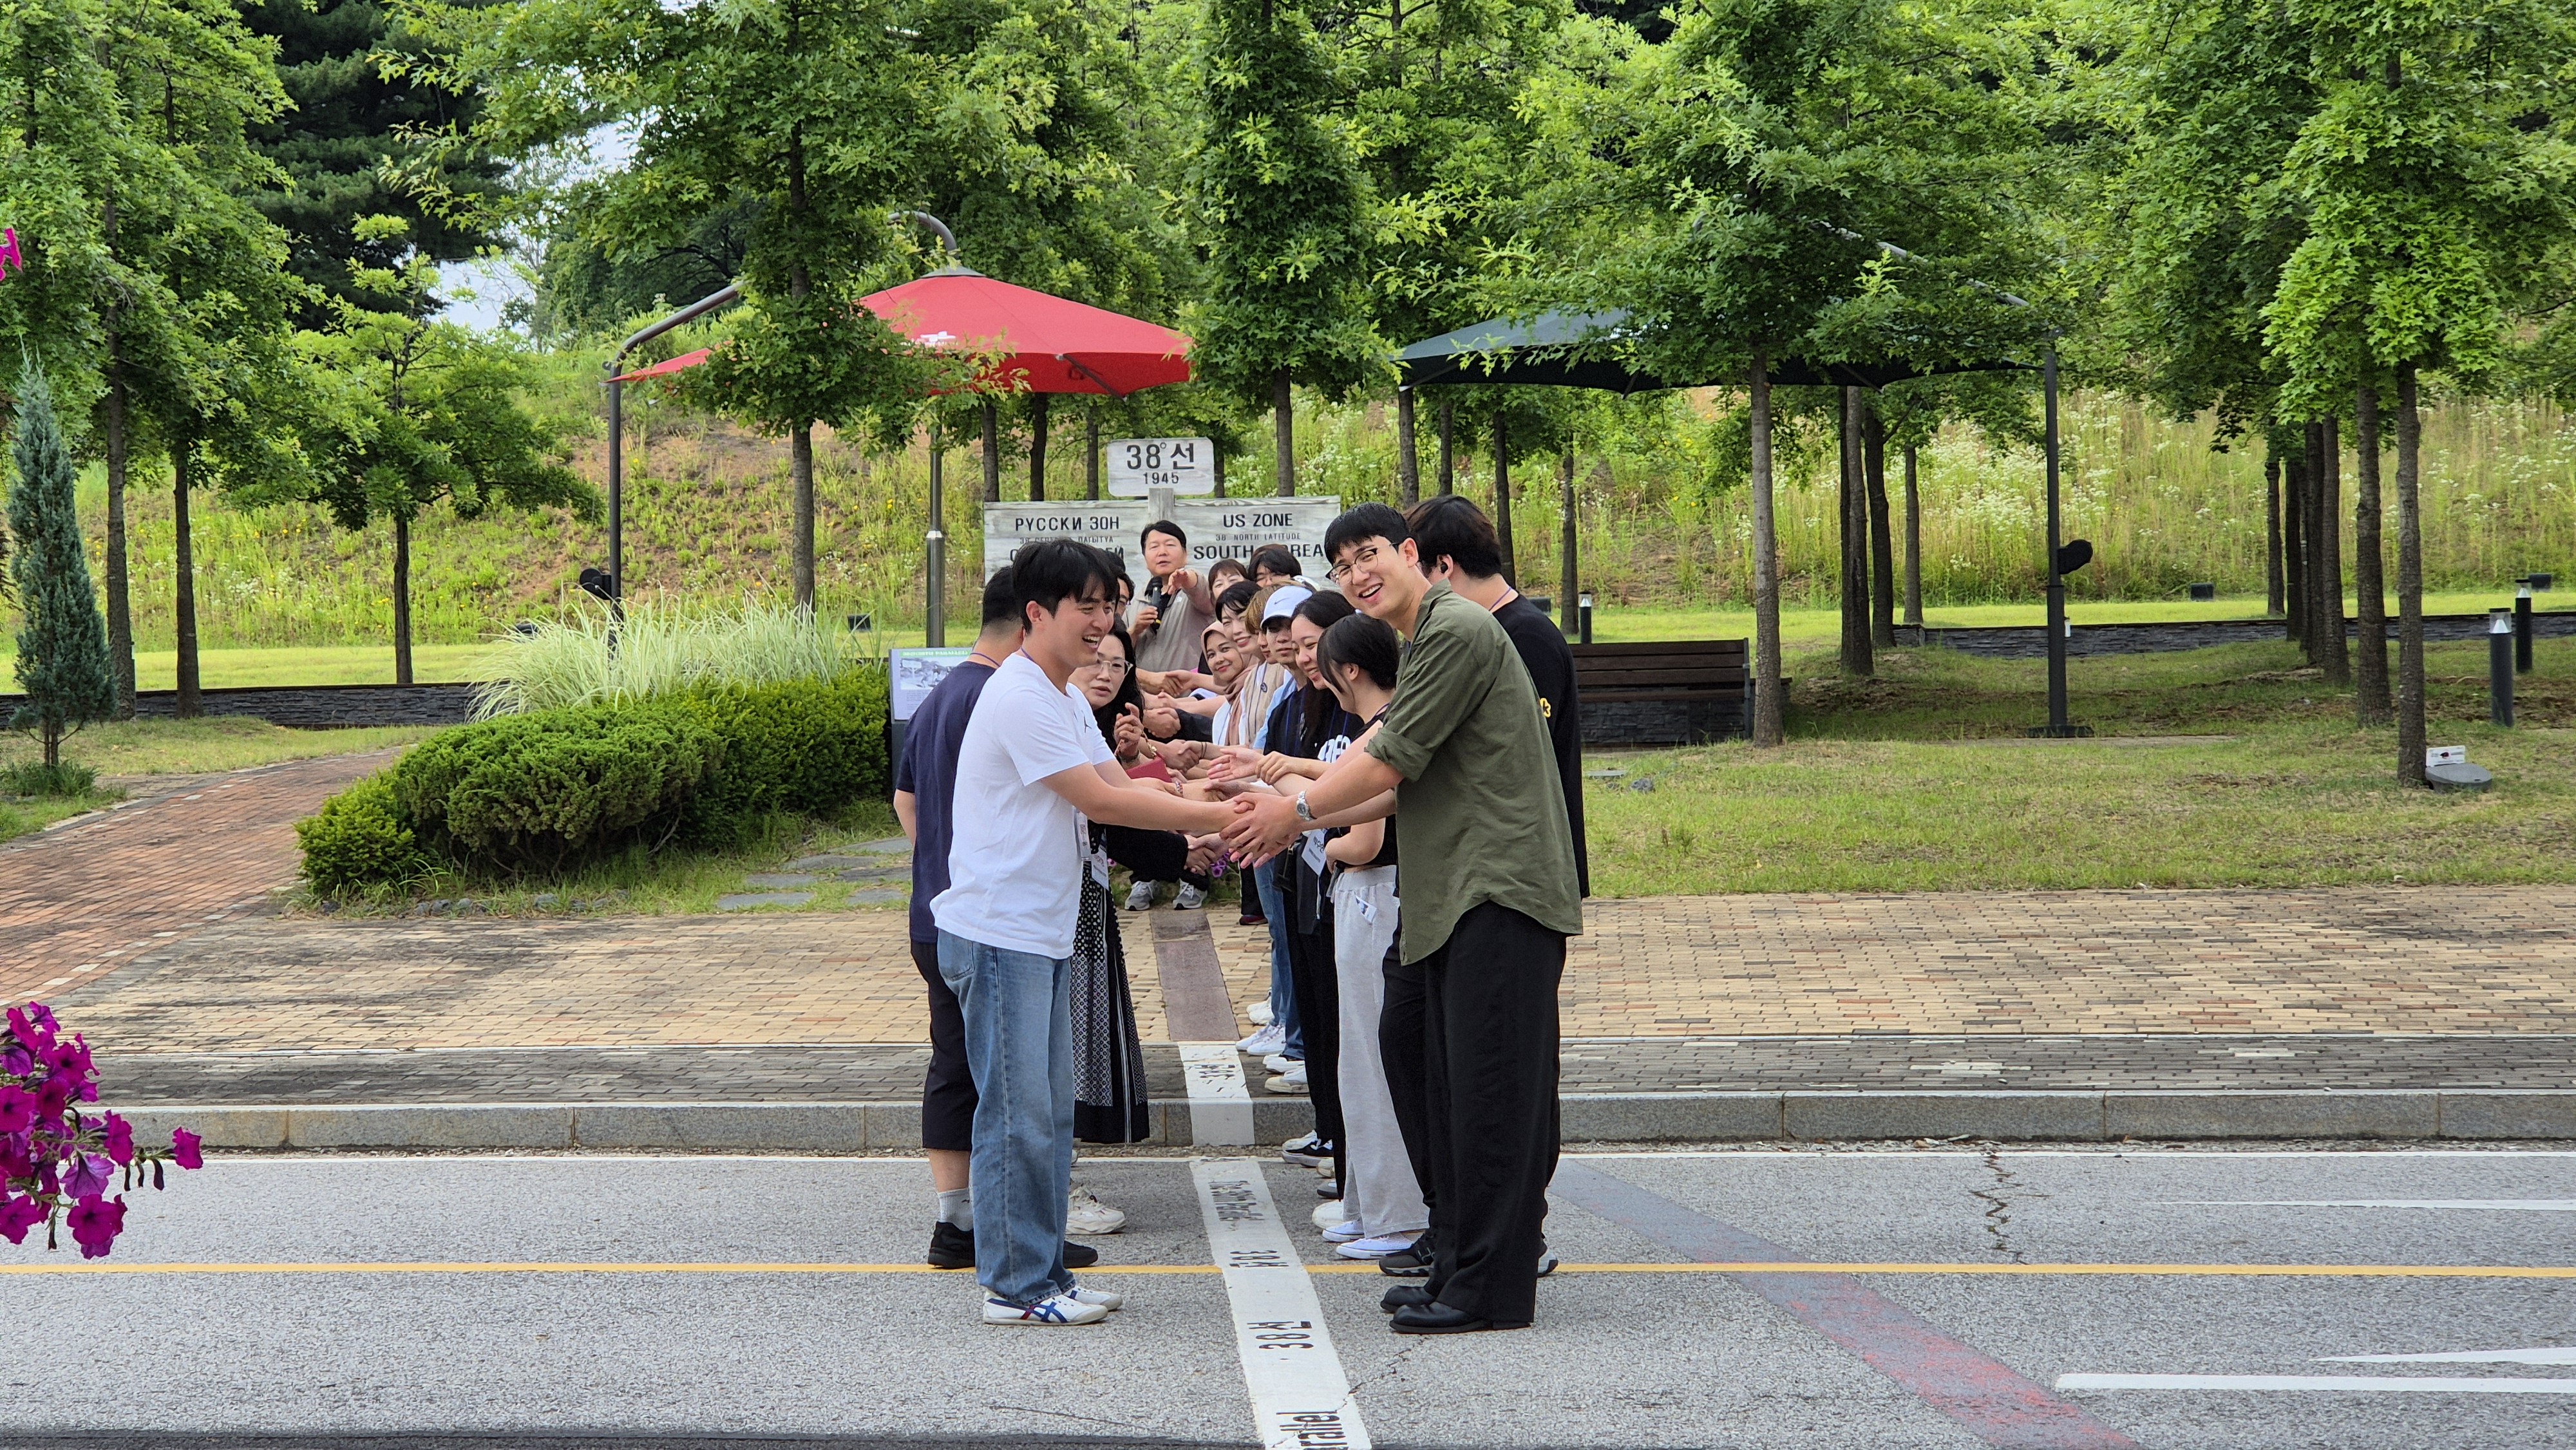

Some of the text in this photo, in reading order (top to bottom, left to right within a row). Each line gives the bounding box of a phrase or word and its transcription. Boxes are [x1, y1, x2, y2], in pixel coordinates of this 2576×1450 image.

[1126, 442, 1195, 470] 38°선
[1143, 472, 1179, 484] 1945
[1015, 516, 1119, 531] РУССКИ ЗОН
[1223, 513, 1293, 527] US ZONE
[1193, 544, 1324, 560] SOUTH REA
[1247, 1320, 1314, 1350] 38선
